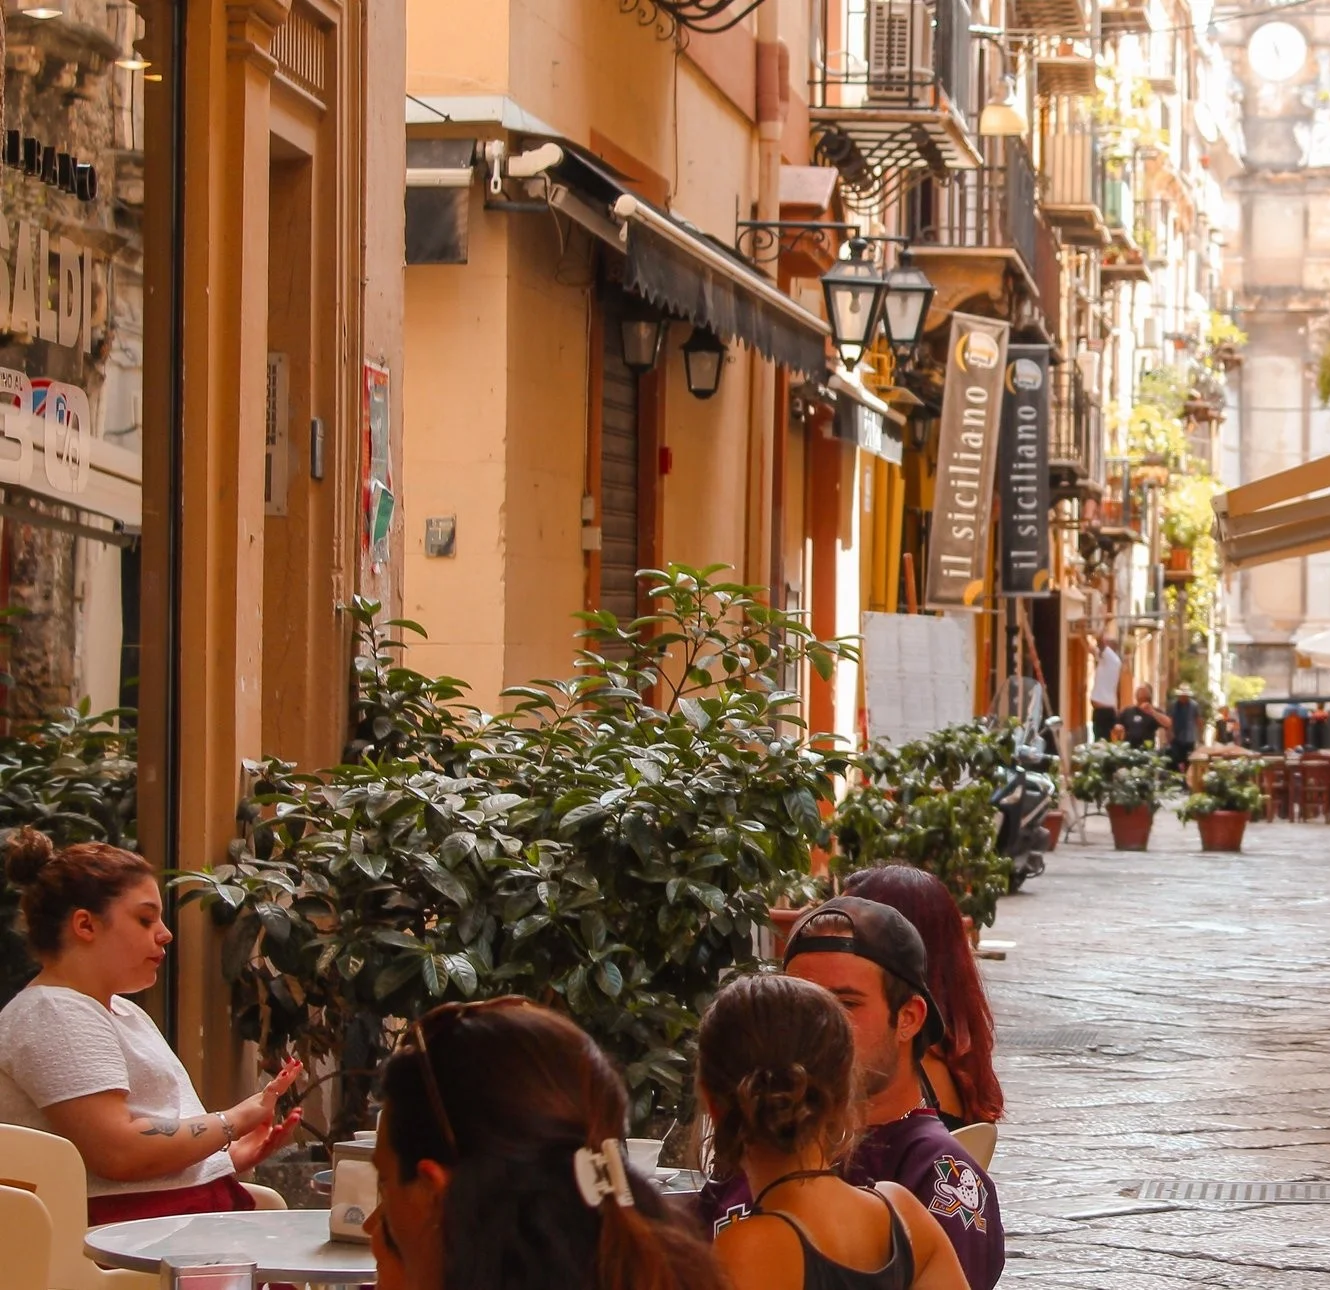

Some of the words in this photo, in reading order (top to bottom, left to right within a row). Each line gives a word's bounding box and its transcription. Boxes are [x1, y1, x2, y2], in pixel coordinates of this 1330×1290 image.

[947, 386, 988, 541] siciliano
[1010, 405, 1037, 537] siciliano
[940, 554, 972, 578] il
[1010, 550, 1037, 568] il
